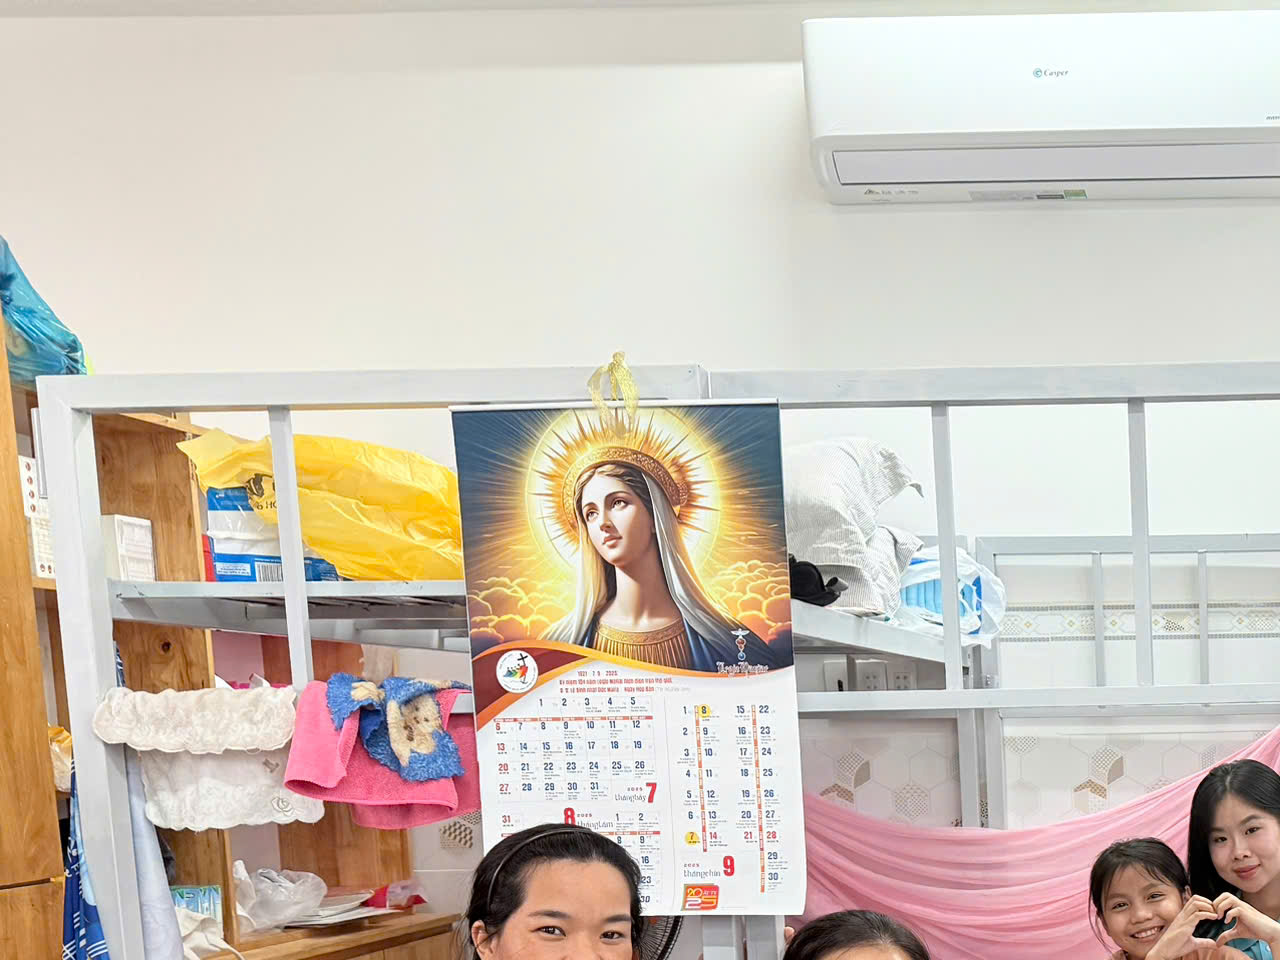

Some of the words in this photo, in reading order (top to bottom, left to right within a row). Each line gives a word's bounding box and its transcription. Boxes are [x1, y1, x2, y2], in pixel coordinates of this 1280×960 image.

[562, 698, 567, 706] 2
[585, 698, 590, 706] 3
[631, 697, 636, 705] 5
[684, 706, 687, 715] 1
[702, 706, 707, 714] 8
[759, 705, 769, 713] 22
[496, 723, 500, 731] 6
[541, 722, 546, 730] 8
[587, 721, 594, 729] 10
[610, 721, 616, 729] 11
[633, 720, 640, 728] 12
[683, 727, 688, 735] 2
[703, 727, 708, 735] 9
[738, 727, 746, 735] 16
[497, 743, 505, 751] 13
[543, 742, 550, 750] 15
[565, 742, 573, 750] 16
[611, 741, 619, 749] 18
[634, 741, 642, 749] 19
[705, 748, 713, 756] 10
[740, 748, 748, 756] 17
[762, 748, 771, 756] 24
[521, 763, 530, 771] 21
[544, 763, 554, 771] 22
[567, 762, 577, 770] 23
[589, 762, 599, 770] 24
[635, 761, 645, 769] 26
[686, 769, 691, 778] 4
[706, 769, 713, 777] 11
[741, 769, 749, 777] 18
[763, 769, 773, 777] 25
[500, 784, 509, 792] 27
[545, 783, 555, 791] 29
[568, 783, 578, 791] 30
[591, 782, 599, 790] 31
[646, 782, 657, 803] 7
[687, 790, 692, 798] 5
[707, 790, 715, 798] 12
[742, 790, 750, 798] 19
[764, 790, 774, 798] 26
[502, 815, 511, 823] 31
[639, 813, 644, 821] 2
[688, 811, 693, 819] 6
[709, 811, 717, 819] 13
[741, 811, 751, 819] 20
[766, 811, 775, 819] 27
[617, 836, 622, 844] 8
[640, 836, 645, 844] 9
[690, 832, 694, 840] 7
[710, 832, 717, 840] 14
[767, 831, 777, 839] 28
[642, 856, 649, 864] 16
[768, 852, 778, 860] 29
[723, 856, 735, 877] 9
